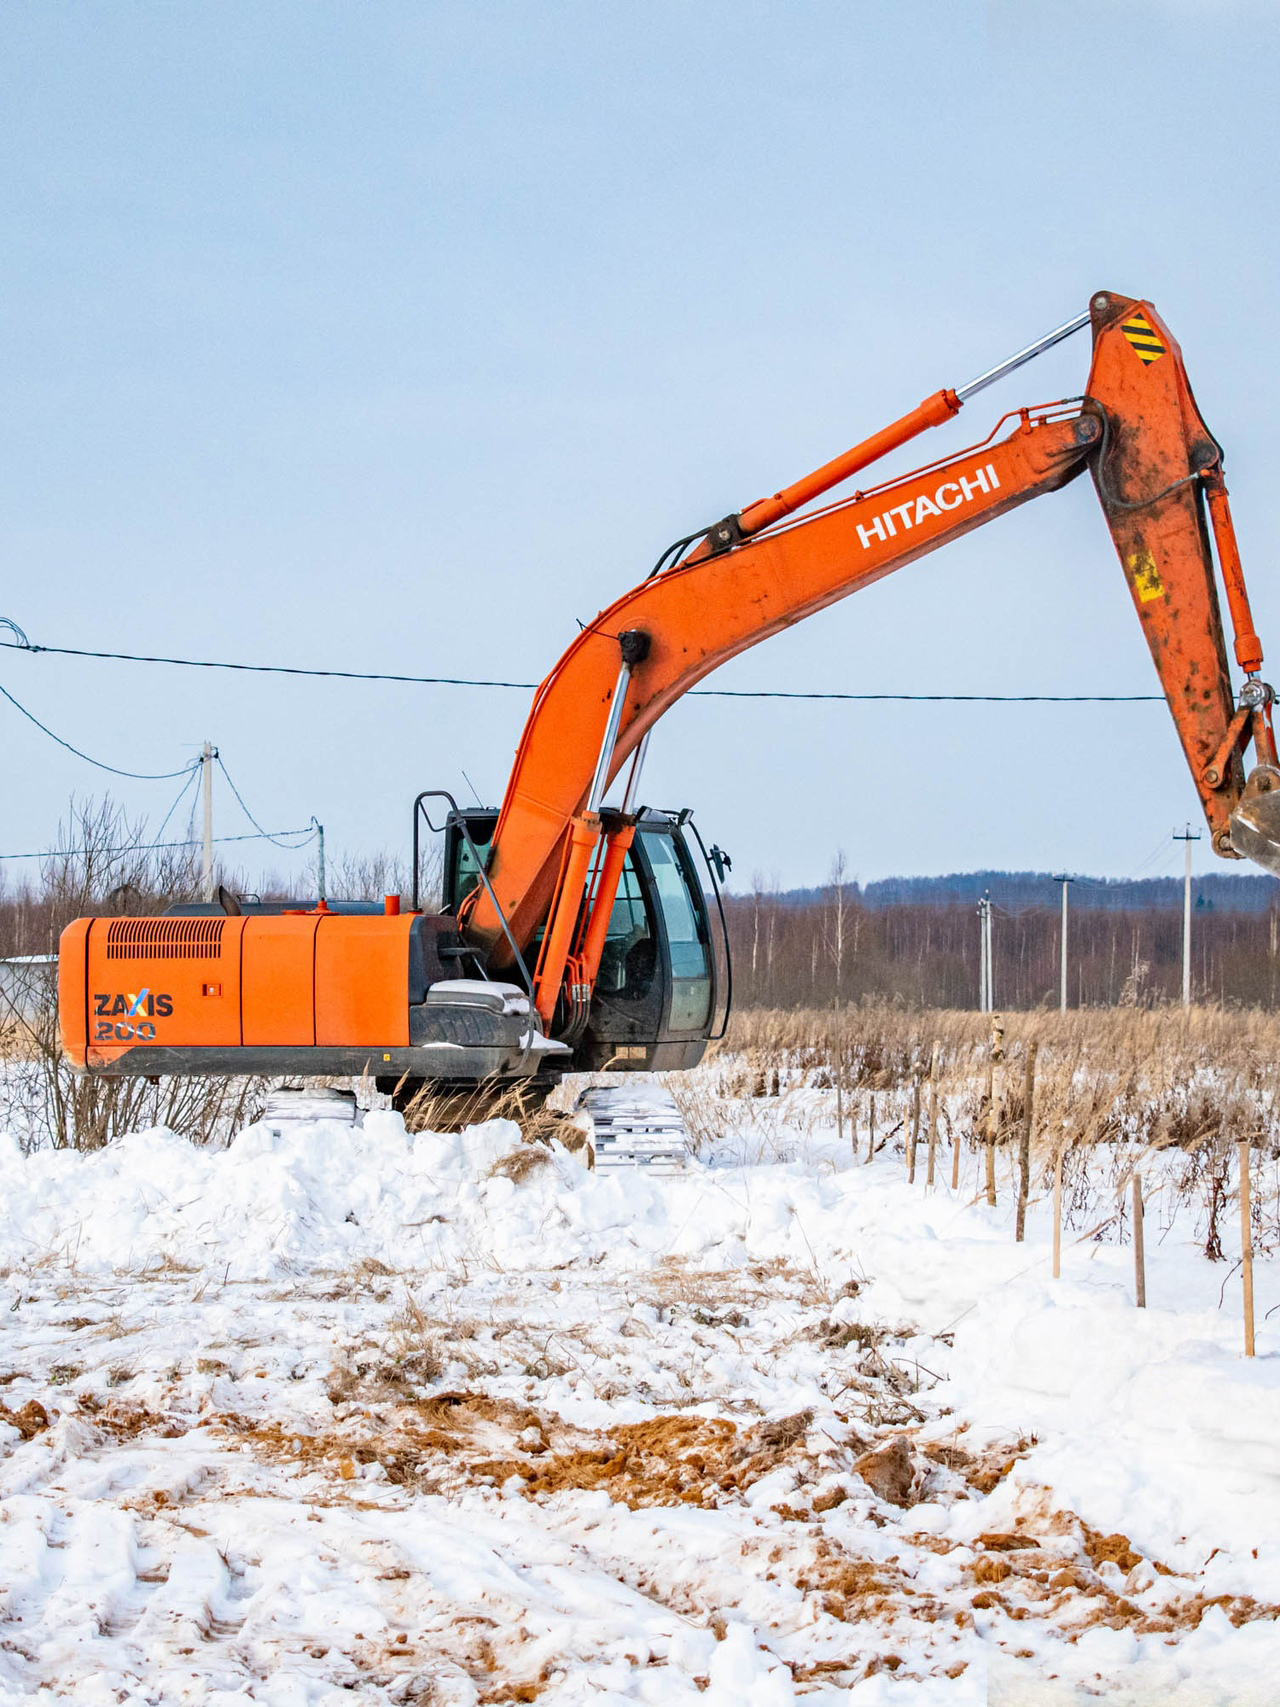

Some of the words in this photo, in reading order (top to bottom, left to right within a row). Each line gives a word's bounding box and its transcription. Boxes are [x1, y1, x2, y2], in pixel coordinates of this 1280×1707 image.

[855, 464, 1000, 549] HITACHI
[94, 988, 173, 1017] ZAXIS
[94, 1022, 156, 1041] 200
